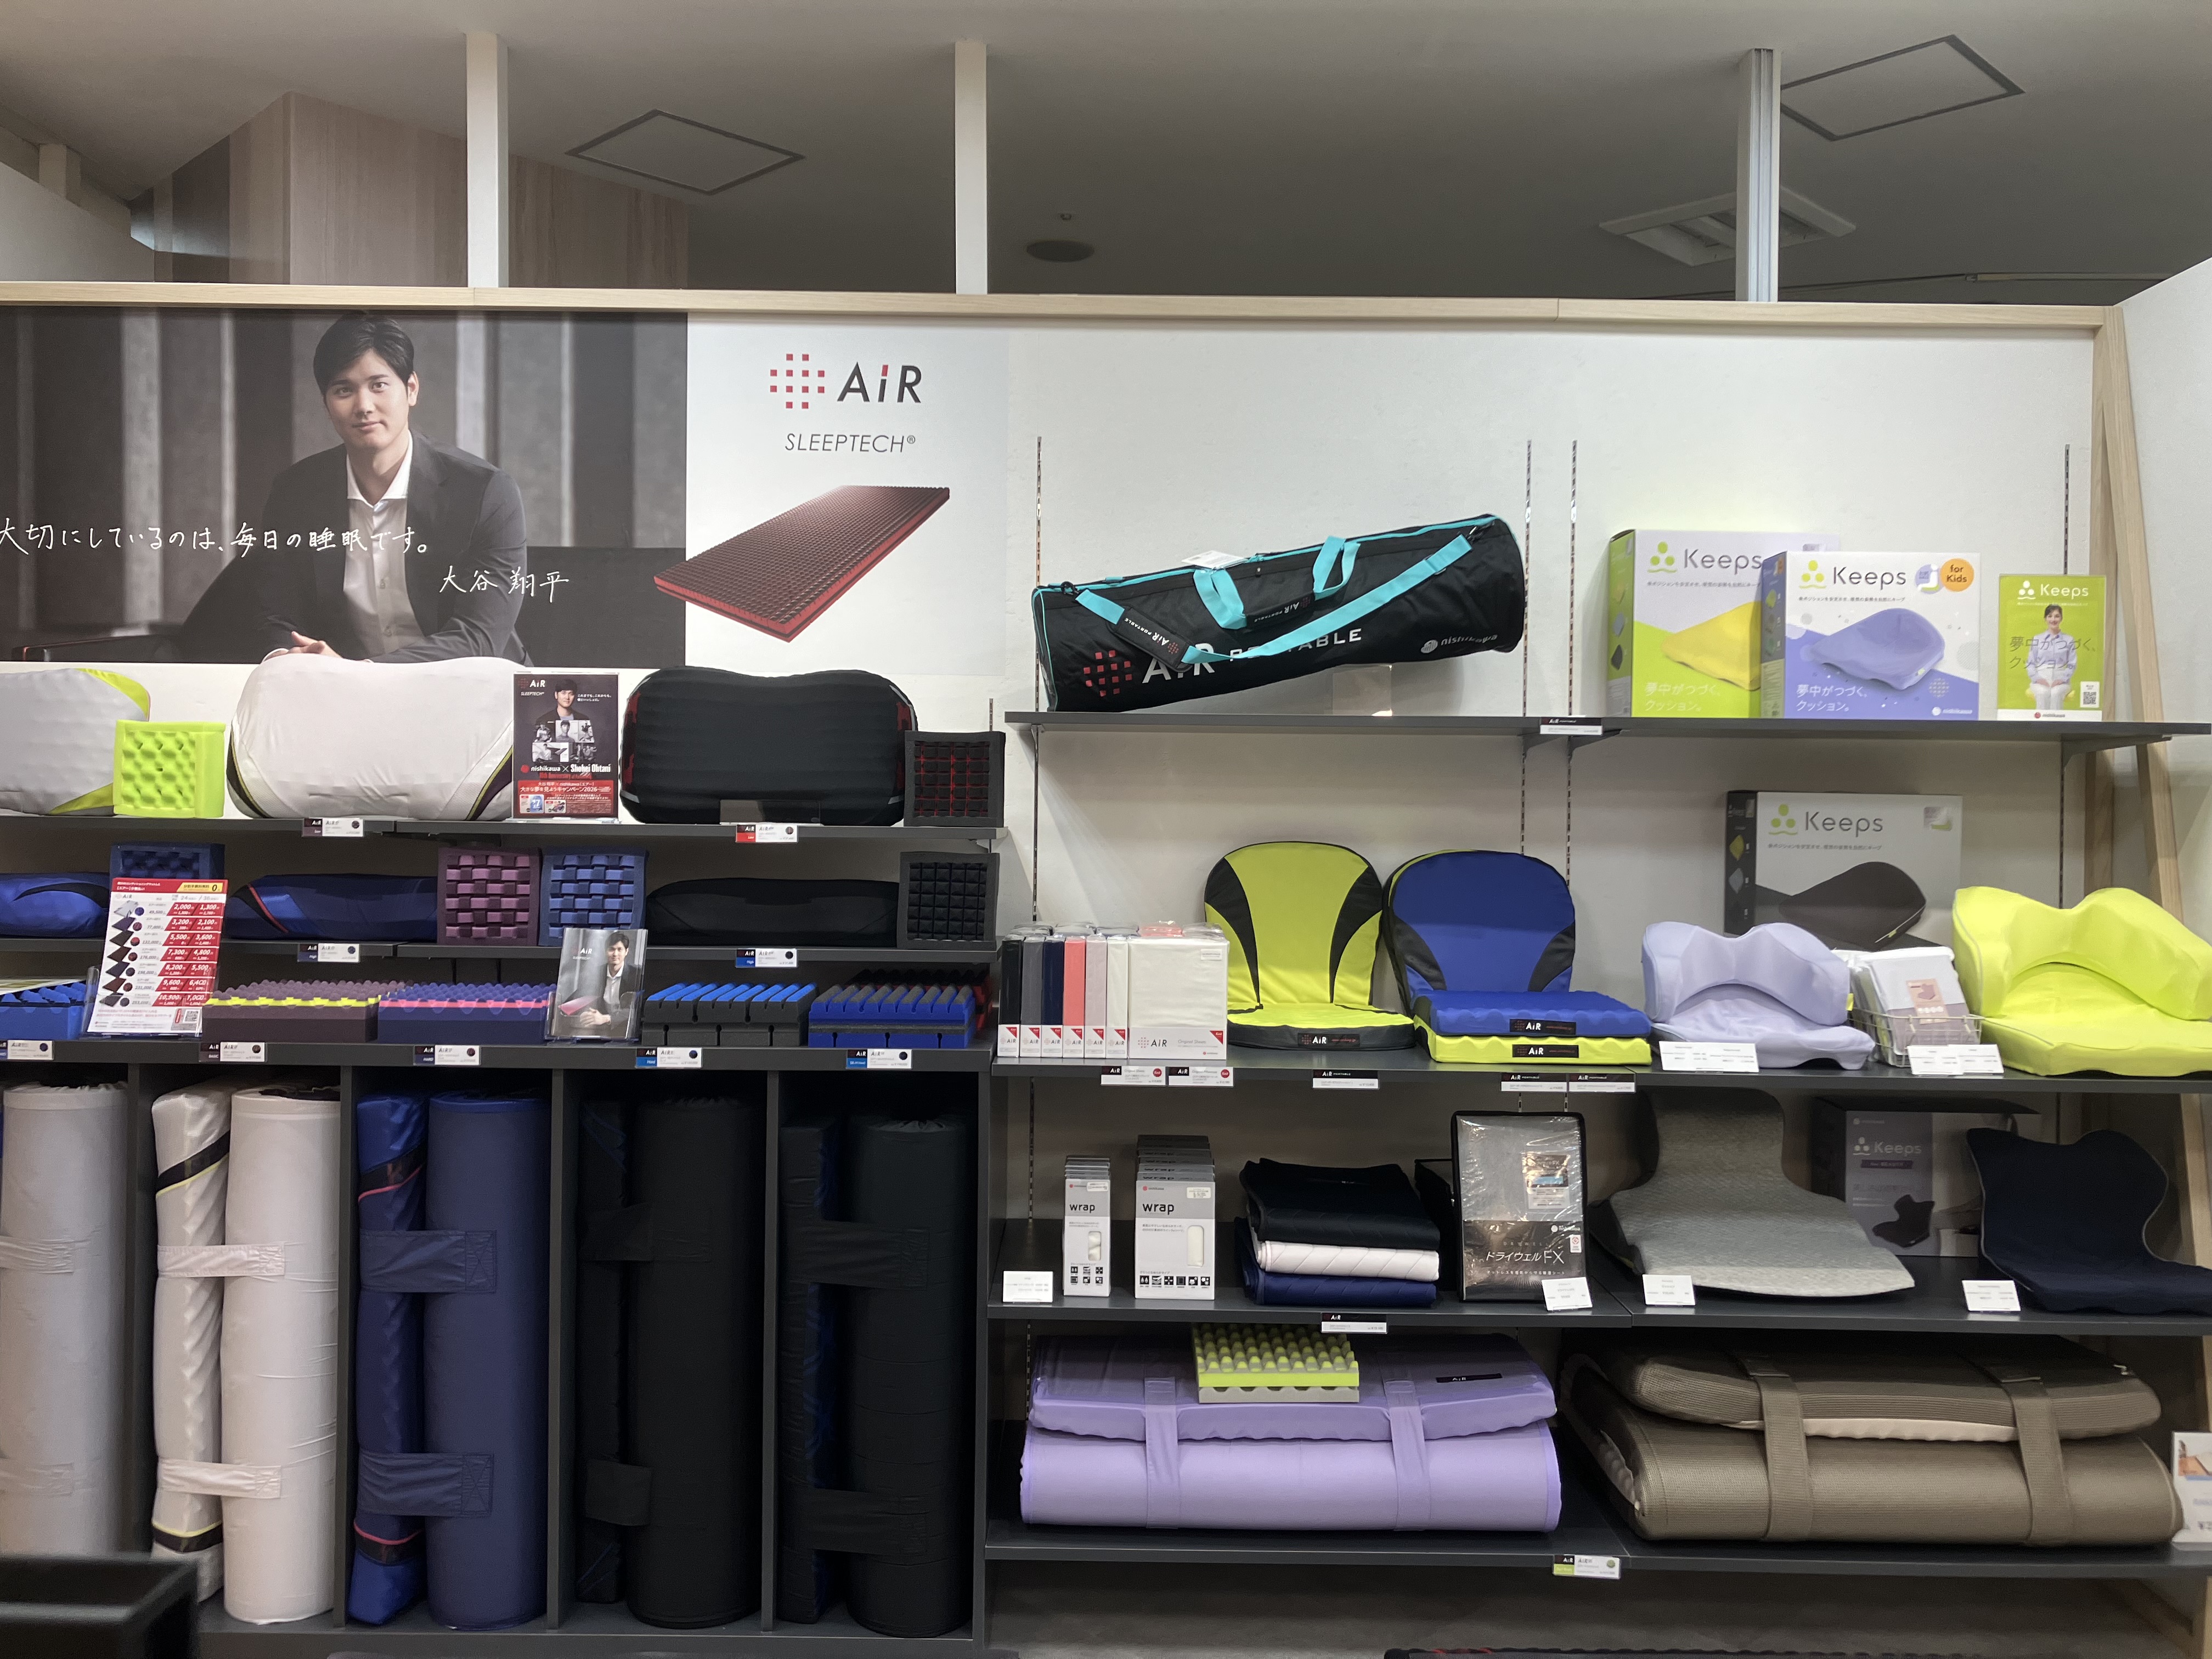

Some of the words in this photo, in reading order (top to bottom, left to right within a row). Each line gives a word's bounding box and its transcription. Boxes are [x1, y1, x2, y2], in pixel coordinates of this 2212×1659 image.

[837, 362, 922, 403] AiR
[1684, 549, 1762, 575] Keeps
[1950, 564, 1964, 573] for
[1833, 566, 1907, 590] Keeps
[1945, 574, 1967, 584] Kids
[2040, 584, 2089, 600] Keeps
[1124, 617, 1152, 635] PORTABLE
[1152, 632, 1170, 646] AiR
[2010, 657, 2074, 669] クッション。
[1796, 700, 1850, 712] クッション。
[570, 764, 590, 772] Shohei
[591, 764, 611, 772] Ohtani
[1804, 811, 1883, 837] Keeps
[1526, 1022, 1541, 1030] AiR
[1312, 1036, 1327, 1044] AiR
[1528, 1047, 1544, 1055] AiR
[1875, 1141, 1922, 1157] Keeps
[1069, 1204, 1095, 1213] wrap
[1142, 1203, 1174, 1215] wrap
